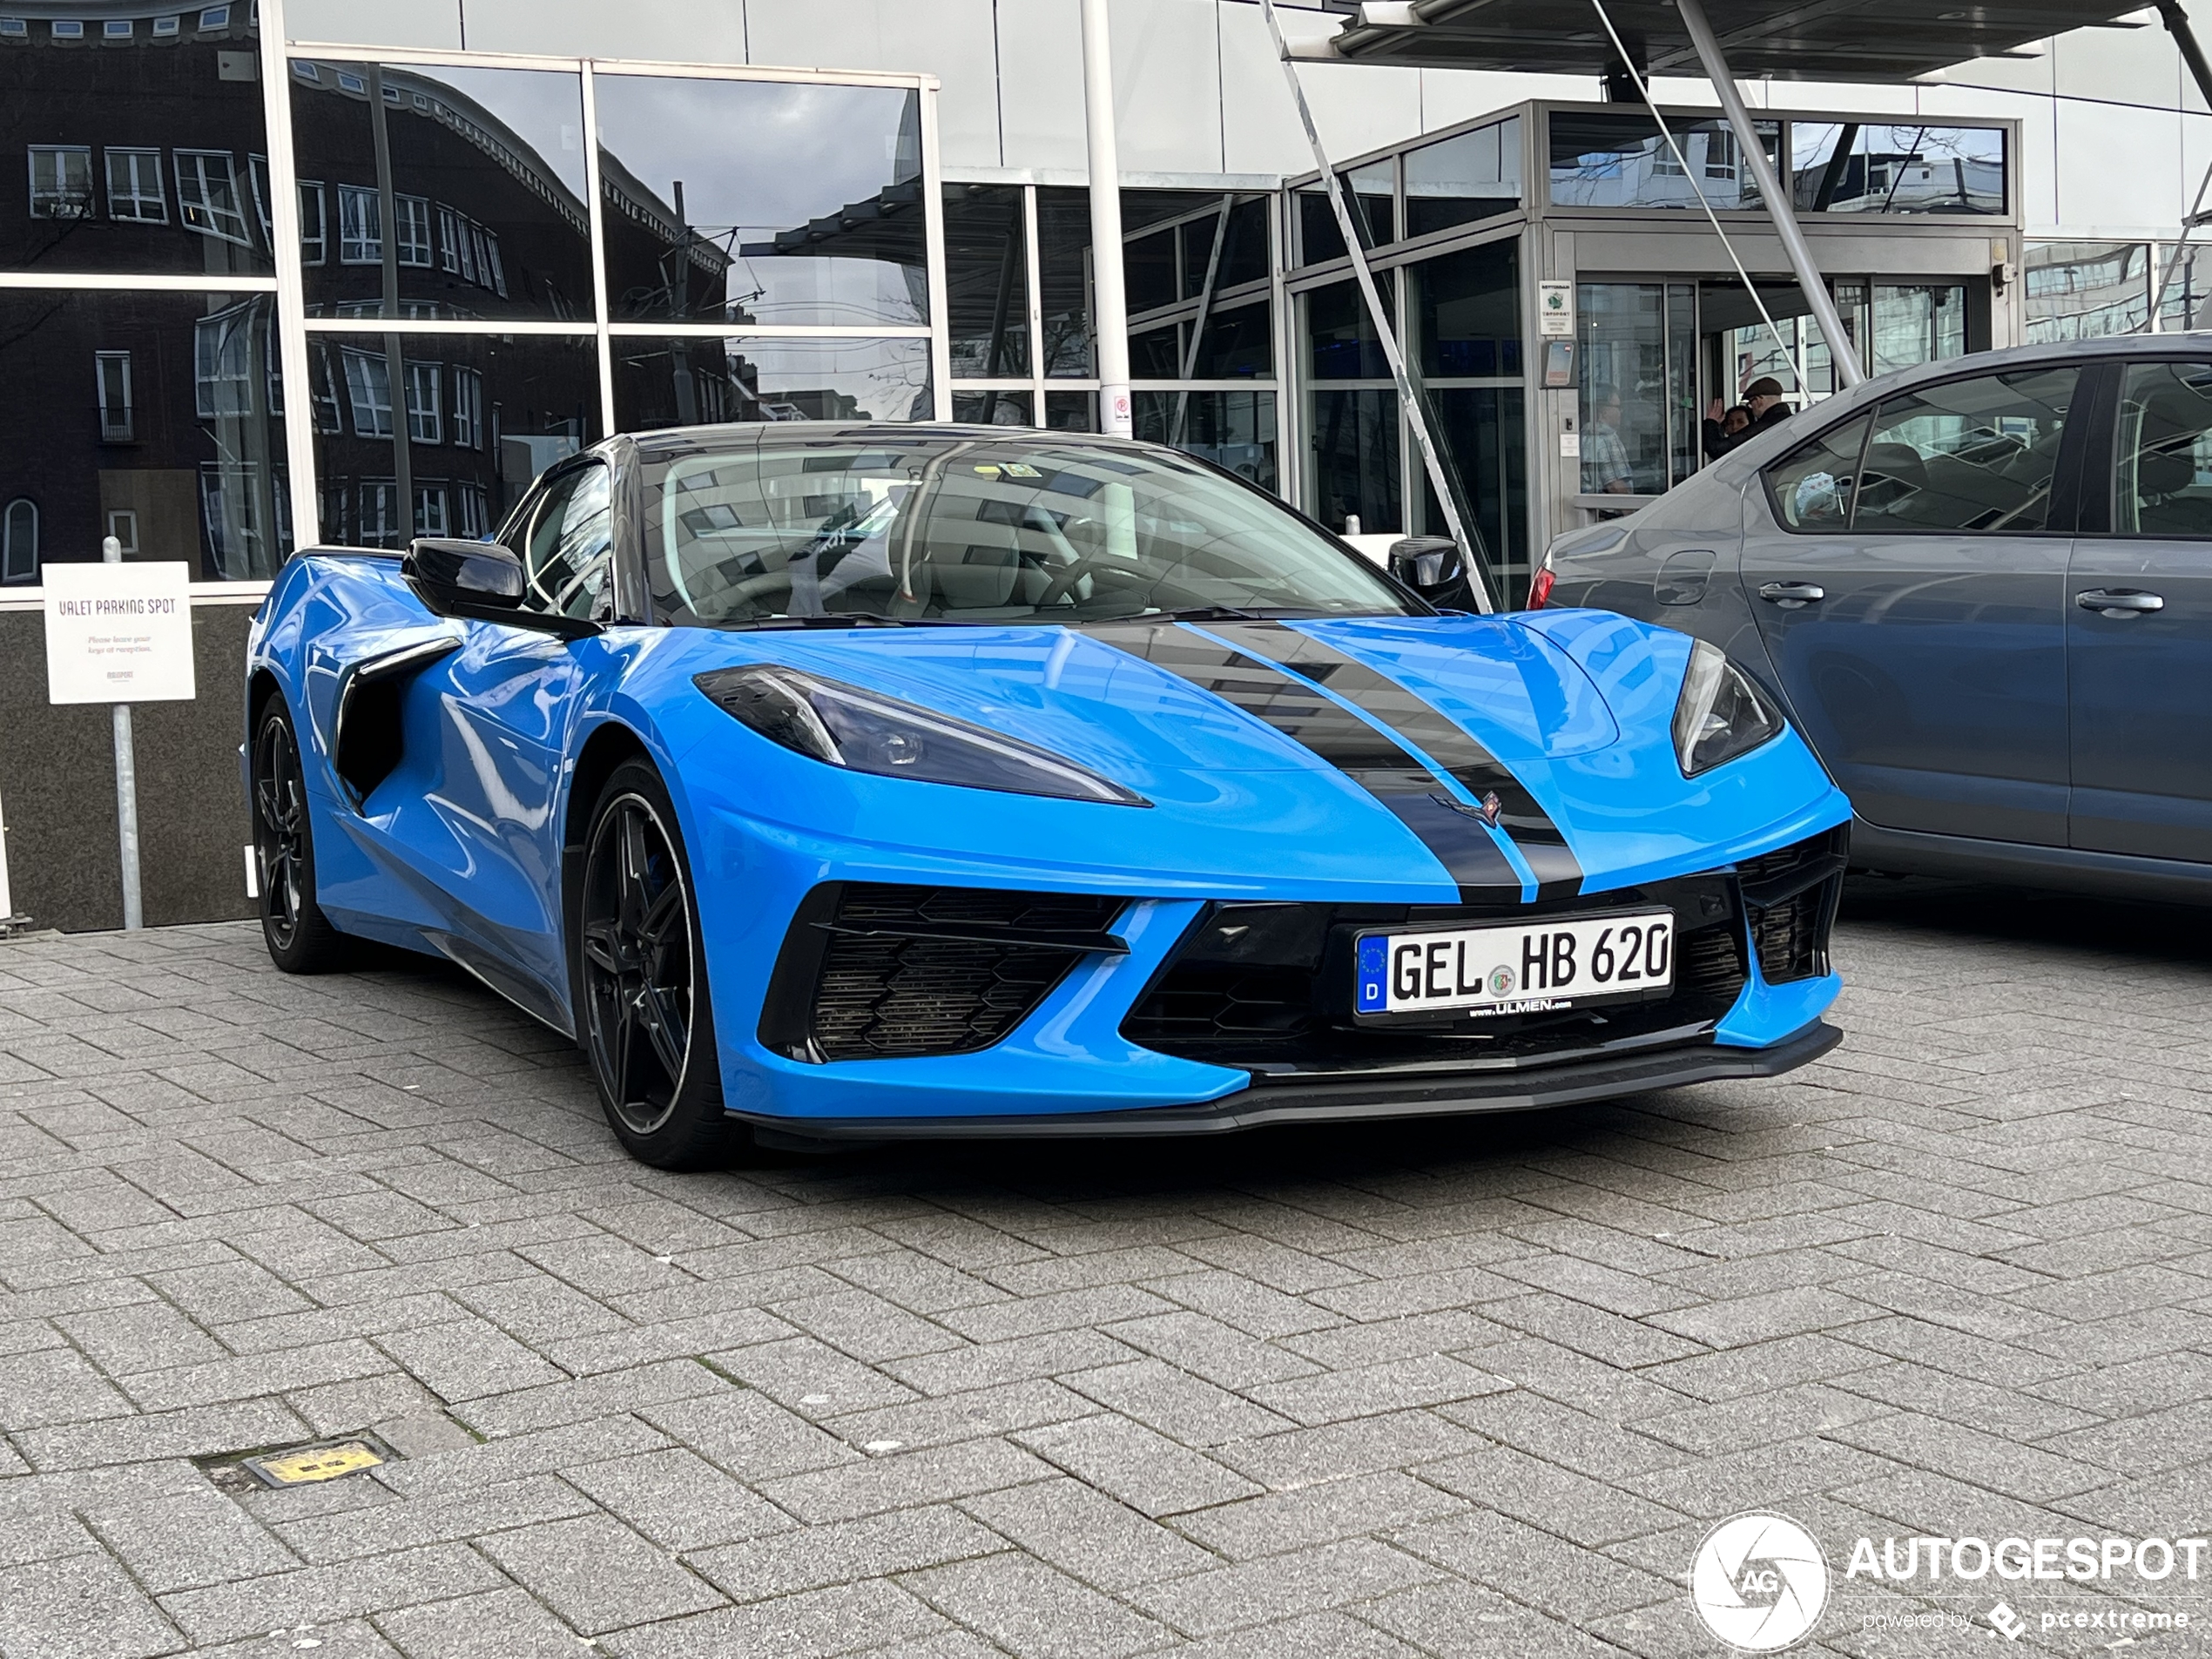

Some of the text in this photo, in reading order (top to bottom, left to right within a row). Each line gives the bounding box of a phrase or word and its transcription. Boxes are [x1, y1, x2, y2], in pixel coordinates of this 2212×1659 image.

[58, 598, 175, 617] VALET PARKING SPOT
[1393, 923, 1668, 1001] GEL HB 620
[1366, 983, 1379, 1001] D
